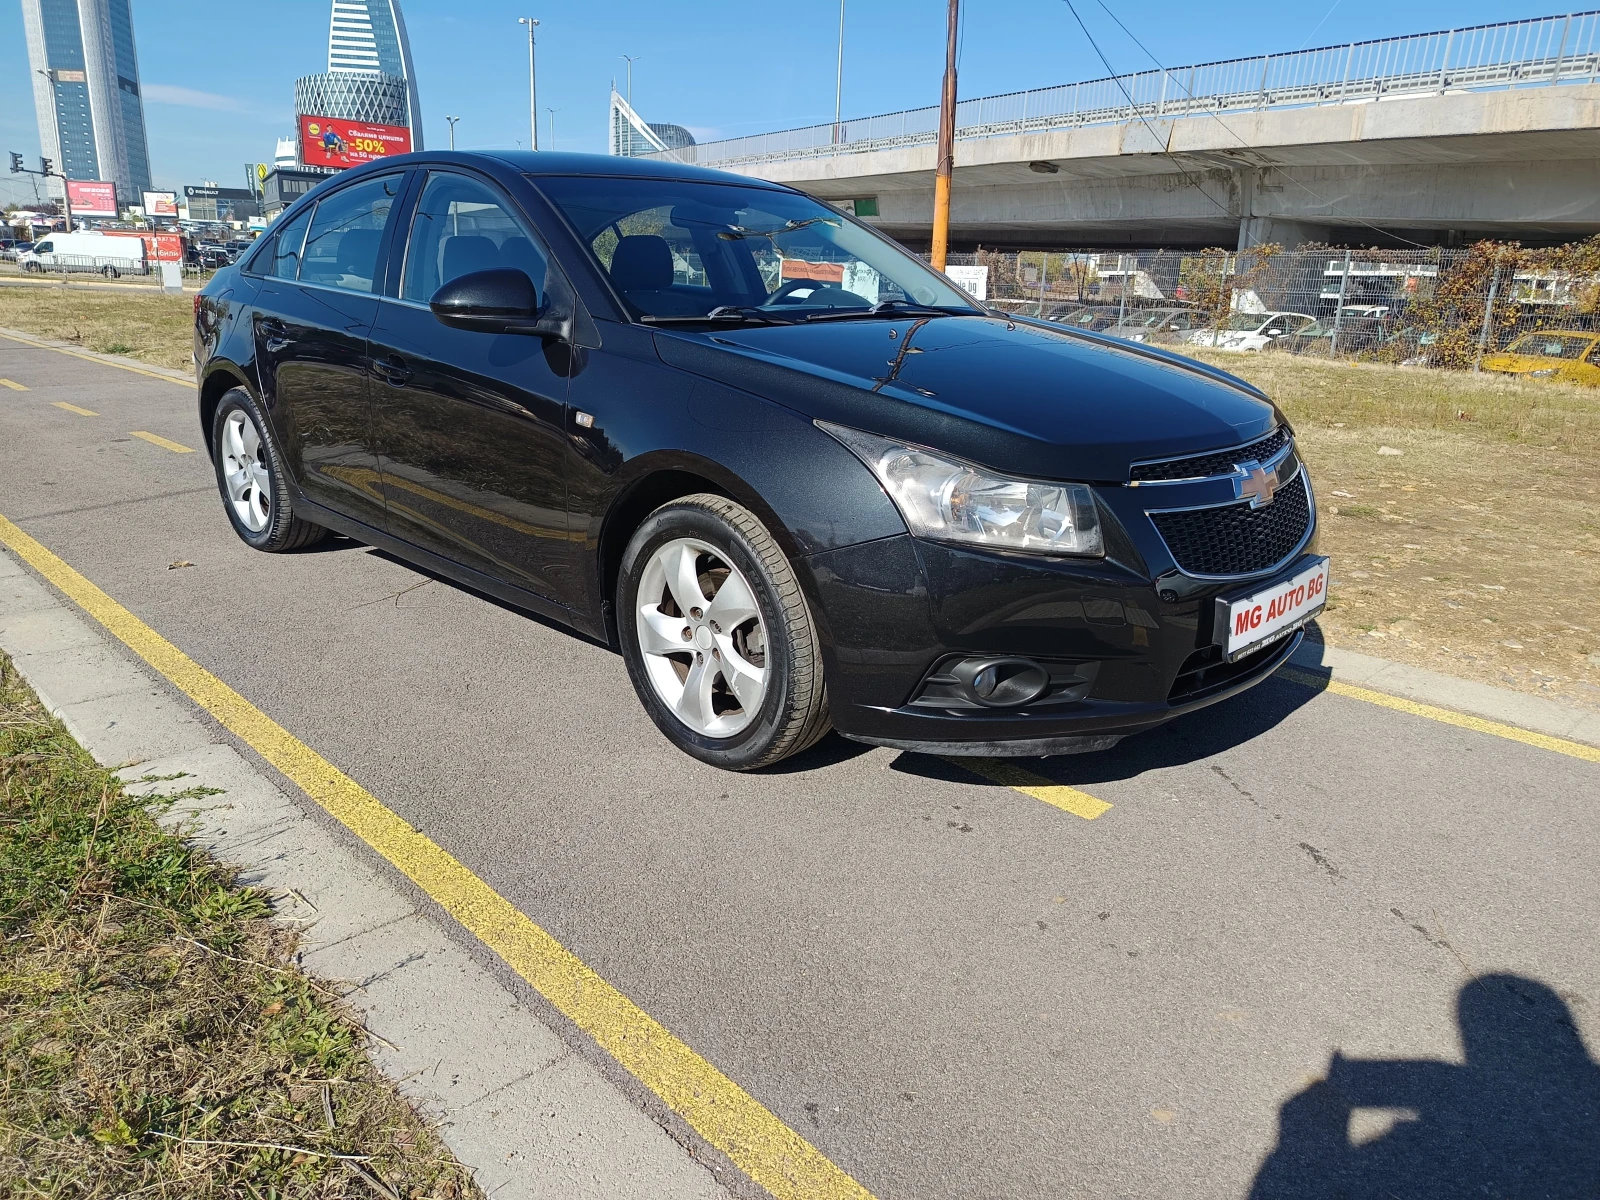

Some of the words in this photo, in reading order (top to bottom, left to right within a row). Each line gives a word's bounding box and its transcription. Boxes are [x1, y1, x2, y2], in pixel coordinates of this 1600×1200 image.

[349, 139, 385, 153] -50%
[1235, 605, 1262, 636] MG
[1266, 585, 1304, 623] AUTO
[1307, 573, 1323, 601] BG
